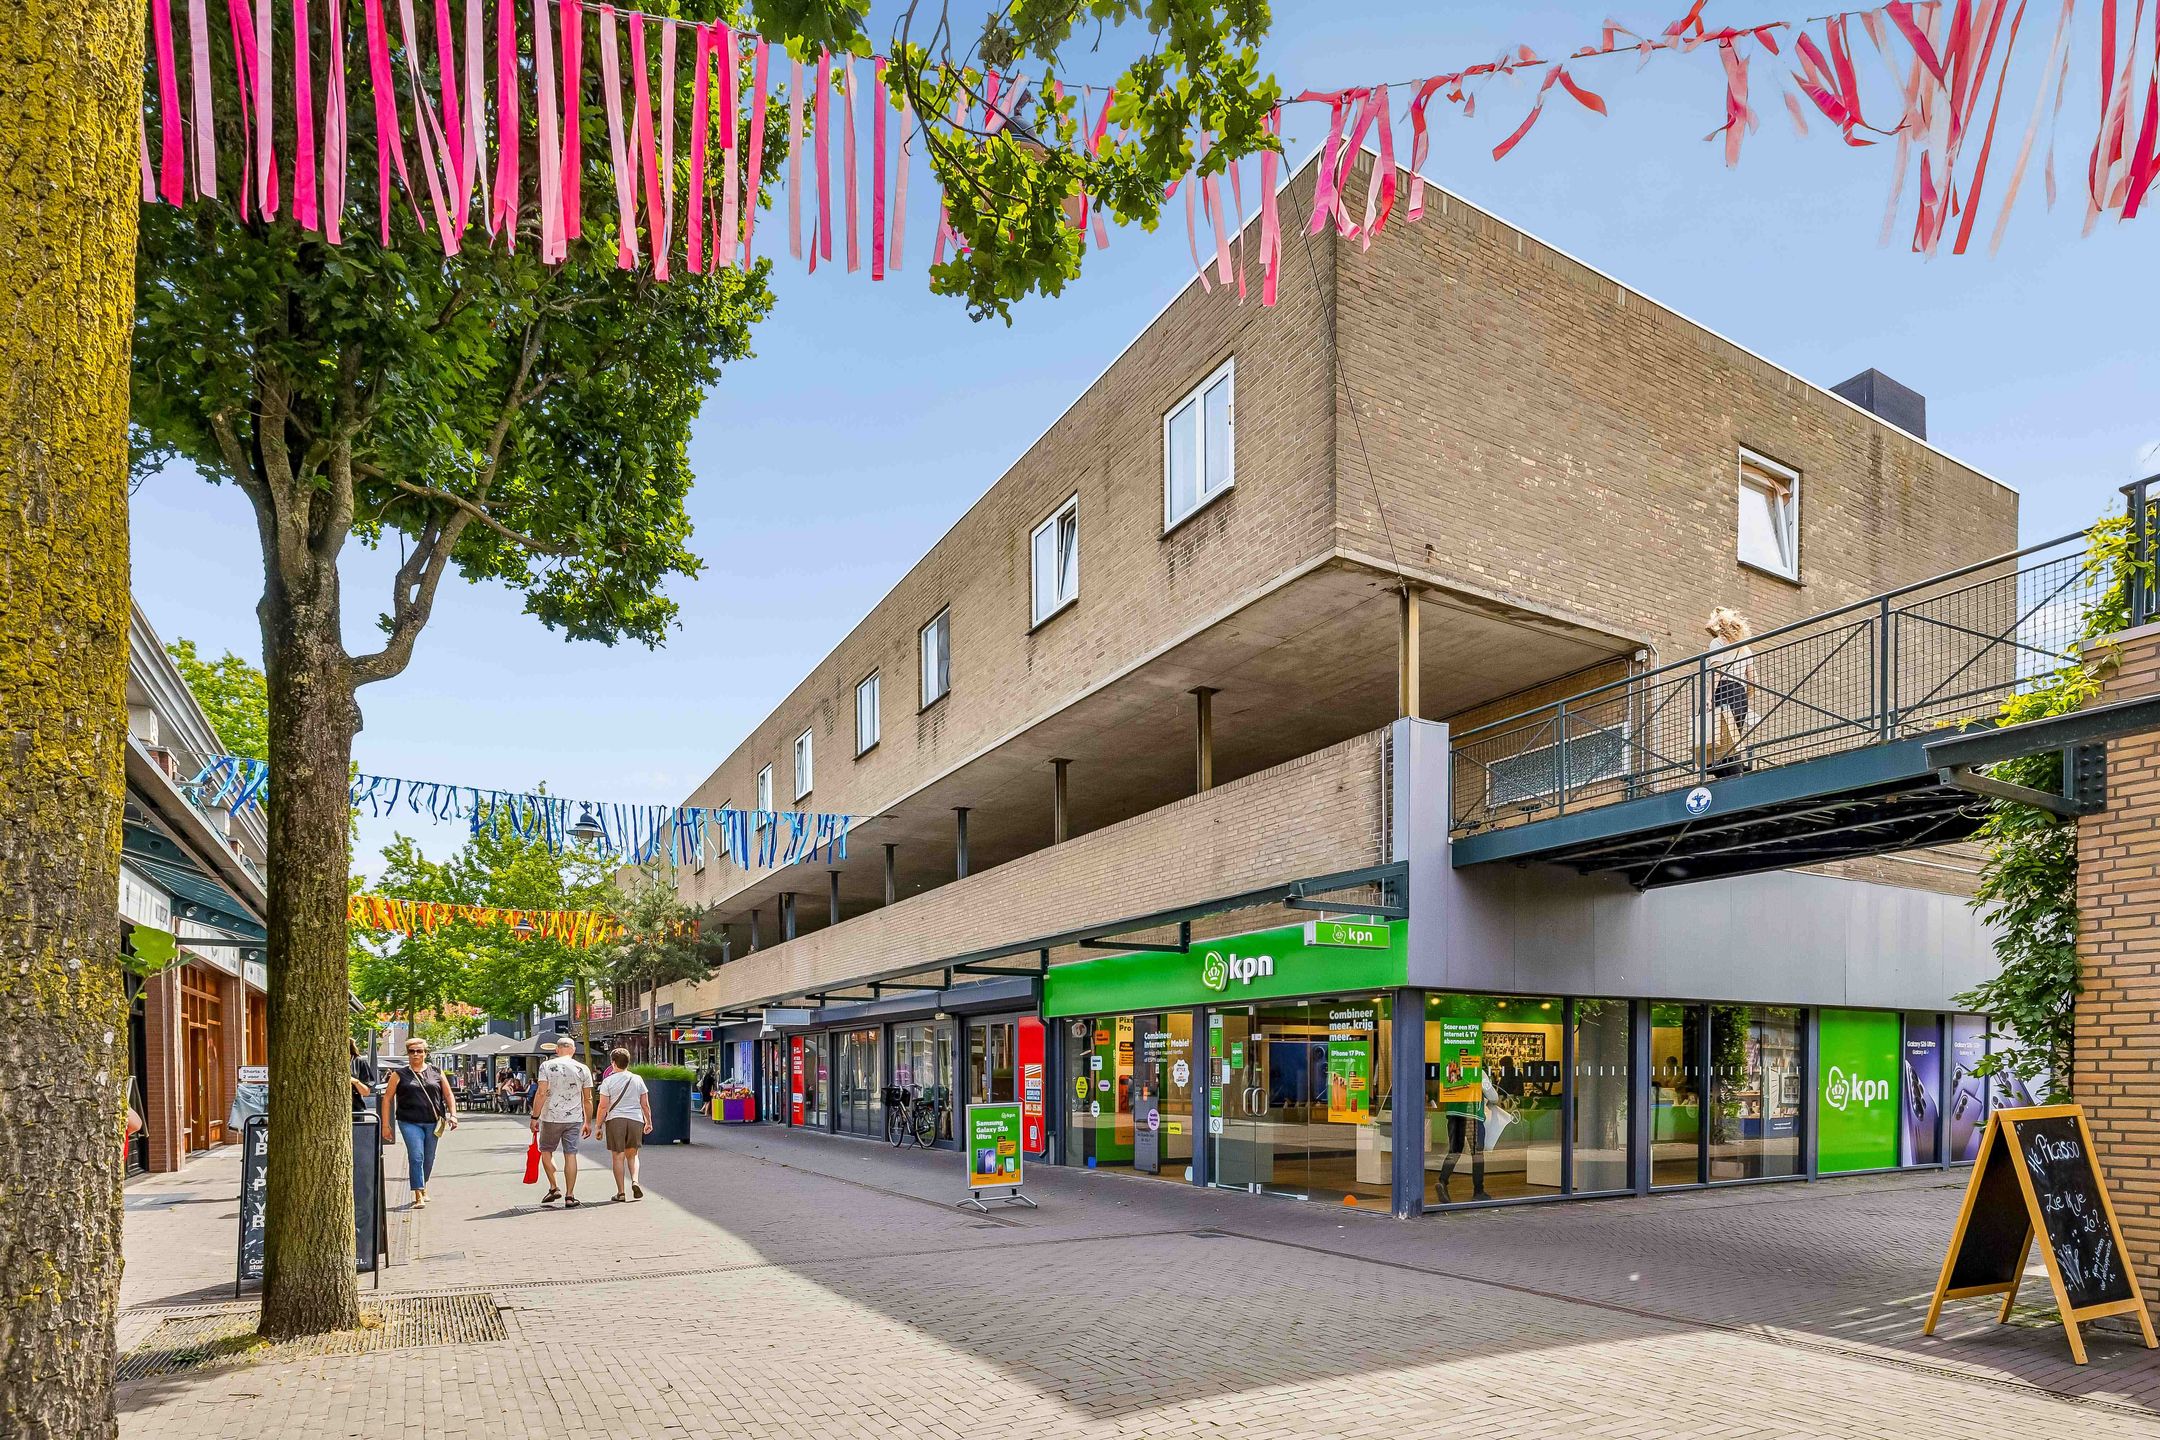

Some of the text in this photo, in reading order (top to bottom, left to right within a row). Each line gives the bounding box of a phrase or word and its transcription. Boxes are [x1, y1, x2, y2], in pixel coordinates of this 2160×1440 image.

[1348, 928, 1373, 944] kpn
[1229, 953, 1274, 985] kpn
[1329, 1008, 1374, 1020] Combineer
[1119, 1024, 1132, 1032] Pro
[1353, 1019, 1374, 1031] krijg
[1144, 1031, 1172, 1040] Combineer
[1143, 1040, 1166, 1048] Internet
[1907, 1040, 1920, 1048] Galaxy
[1852, 1073, 1889, 1108] kpn
[2035, 1133, 2080, 1163] Picasso
[2044, 1193, 2064, 1212] Zie
[2074, 1190, 2087, 1212] je
